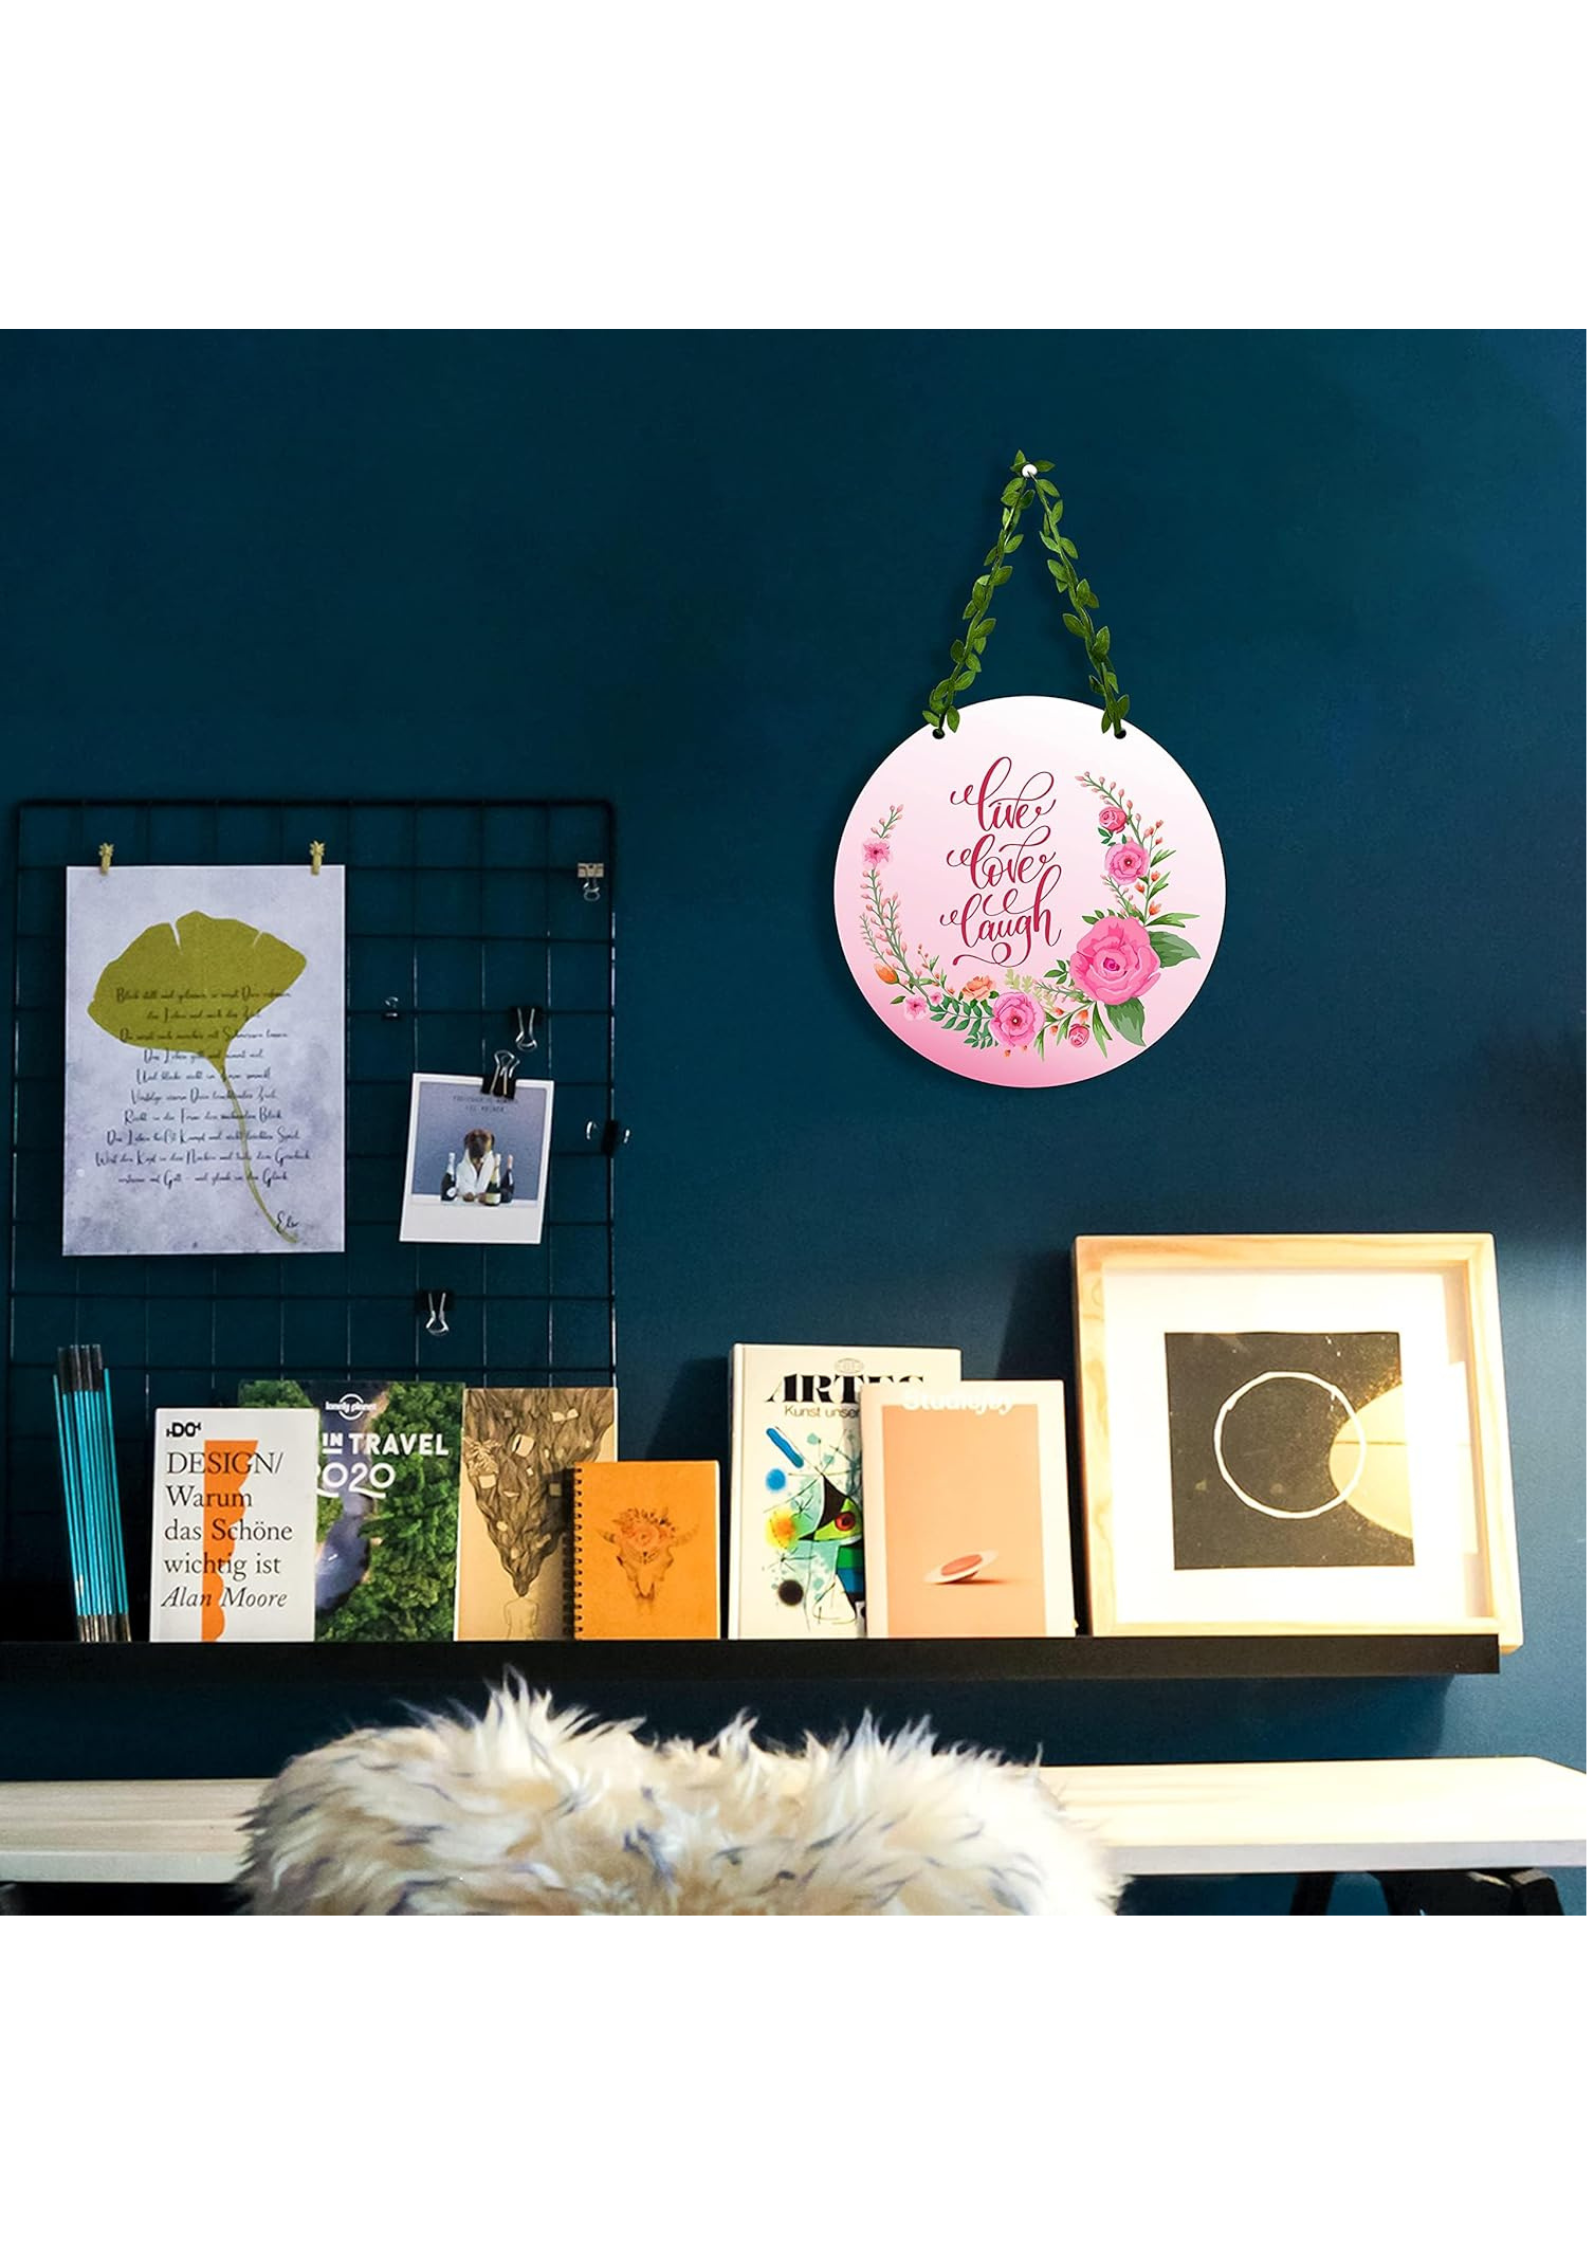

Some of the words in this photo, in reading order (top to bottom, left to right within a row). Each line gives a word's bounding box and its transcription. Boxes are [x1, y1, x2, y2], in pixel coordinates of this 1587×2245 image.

[950, 757, 1056, 831] live
[947, 826, 1056, 889] love
[940, 865, 1061, 967] laugh
[784, 1405, 821, 1418] Kunst
[322, 1432, 343, 1449] IN
[348, 1433, 449, 1455] TRAVEL
[167, 1451, 284, 1474] DESIGN/
[166, 1485, 252, 1507] Warum
[164, 1518, 202, 1541] das
[211, 1518, 293, 1541] Schöne
[164, 1551, 247, 1581] wichtig
[256, 1552, 282, 1574] ist
[161, 1586, 212, 1607] Alan
[221, 1586, 288, 1607] Moore
